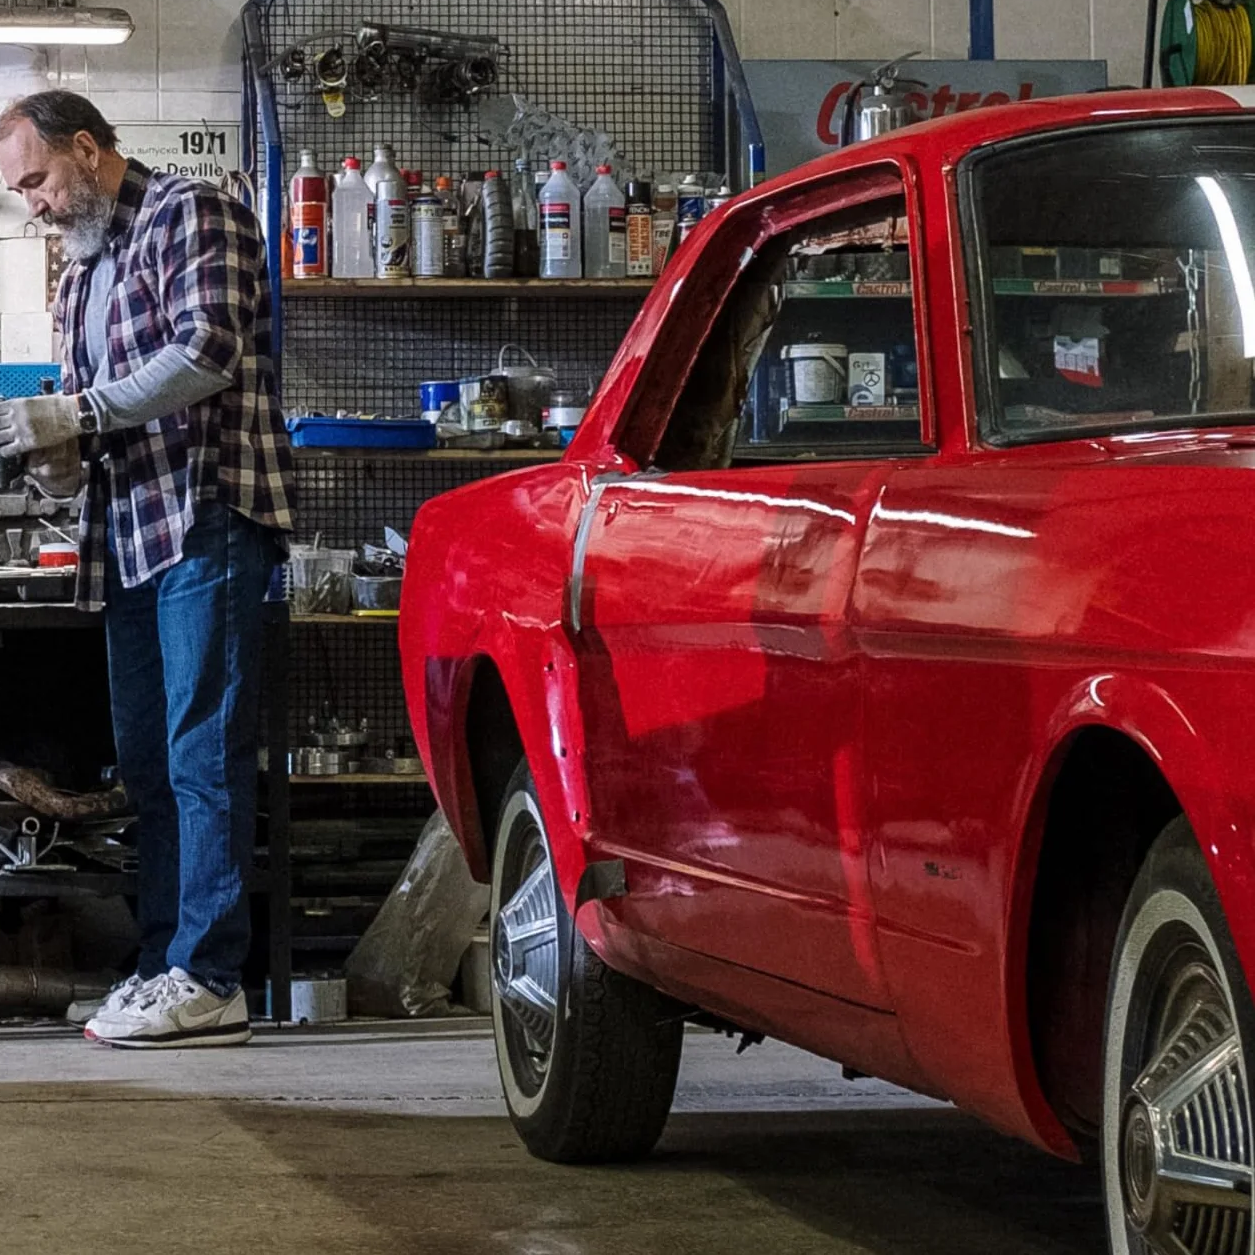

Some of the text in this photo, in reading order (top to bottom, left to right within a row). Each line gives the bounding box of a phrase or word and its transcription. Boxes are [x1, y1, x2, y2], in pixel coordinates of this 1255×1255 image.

[179, 131, 226, 154] 1971
[167, 162, 224, 177] Deville
[855, 283, 904, 295] Castrol
[848, 407, 895, 419] Castrol
